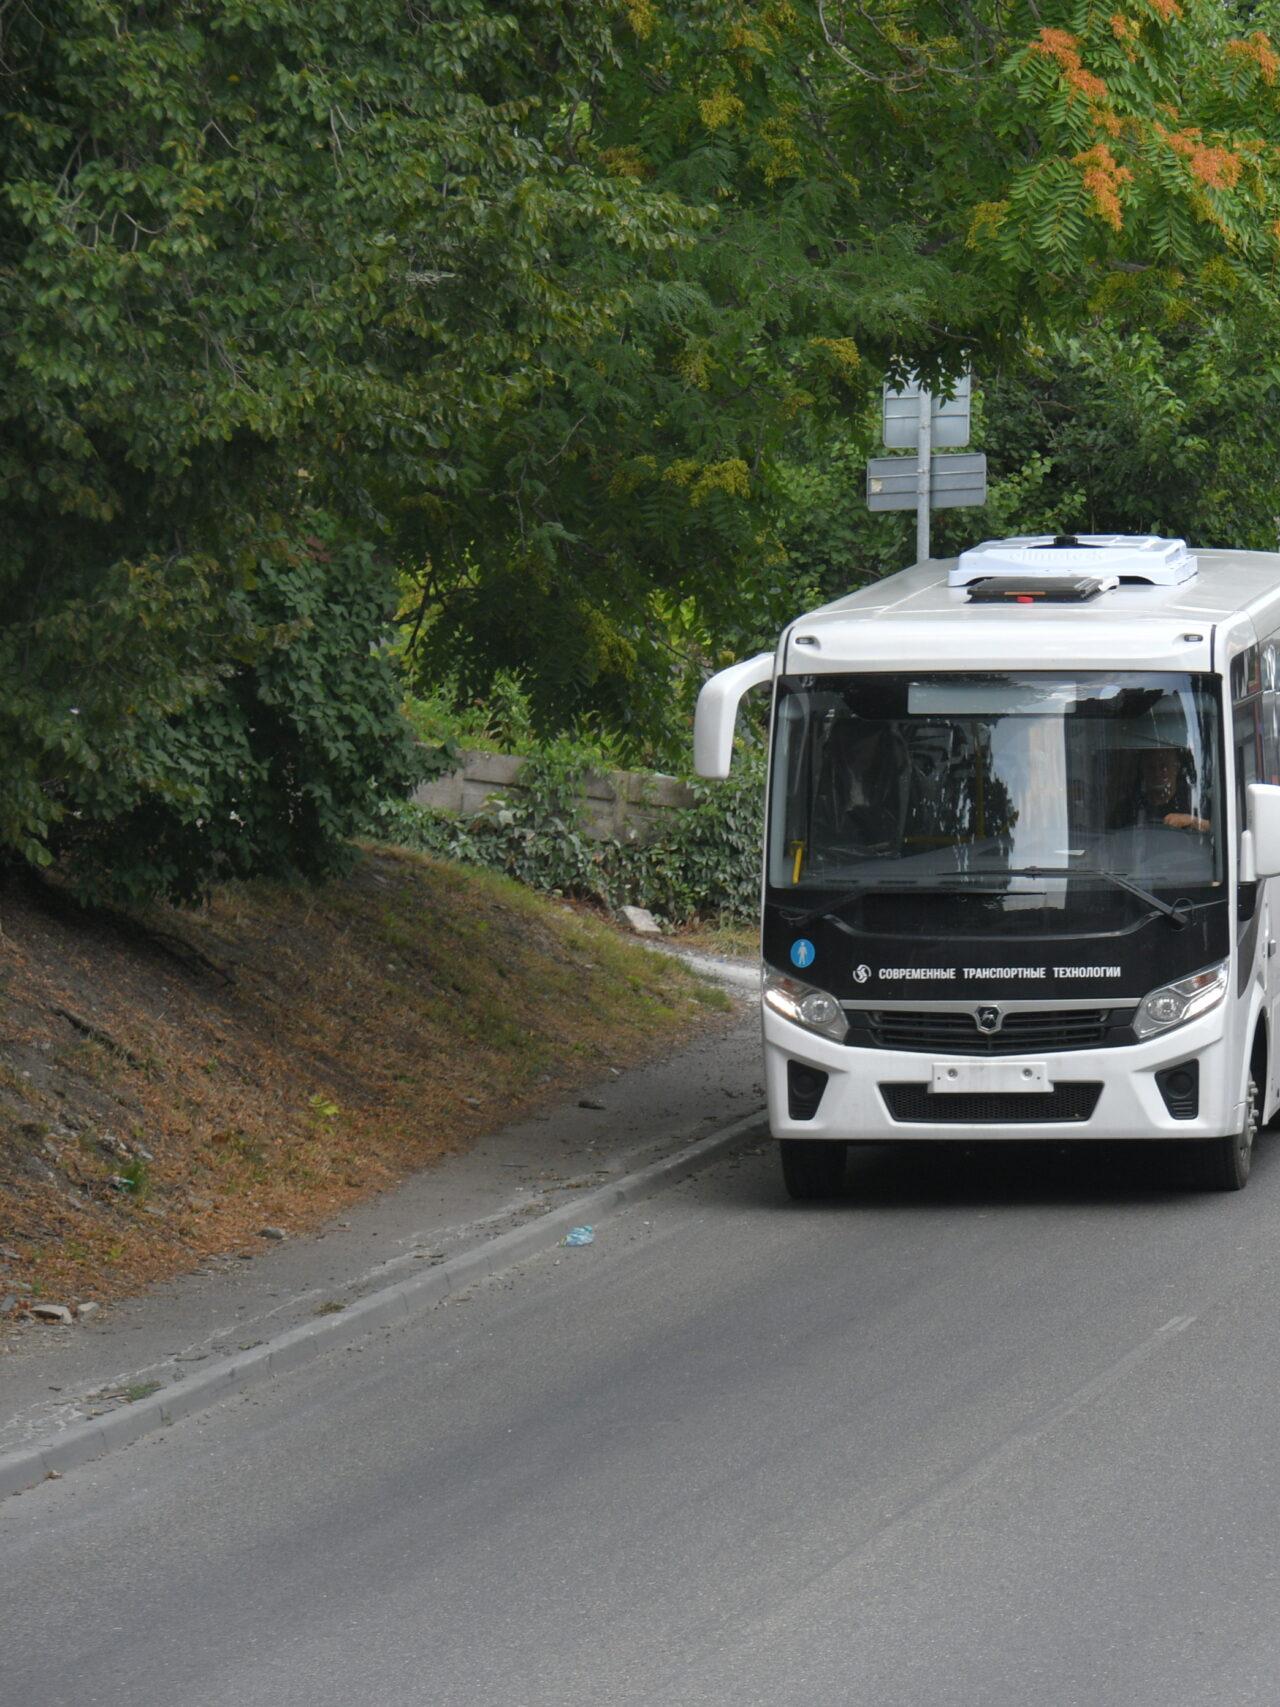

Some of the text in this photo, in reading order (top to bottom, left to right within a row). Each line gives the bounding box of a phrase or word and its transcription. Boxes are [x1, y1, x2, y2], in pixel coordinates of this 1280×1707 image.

[878, 966, 1121, 980] СОВРЕМЕННЫЕ ТРАНСПОРТНЫЕ ТЕХНОЛОГИИ
